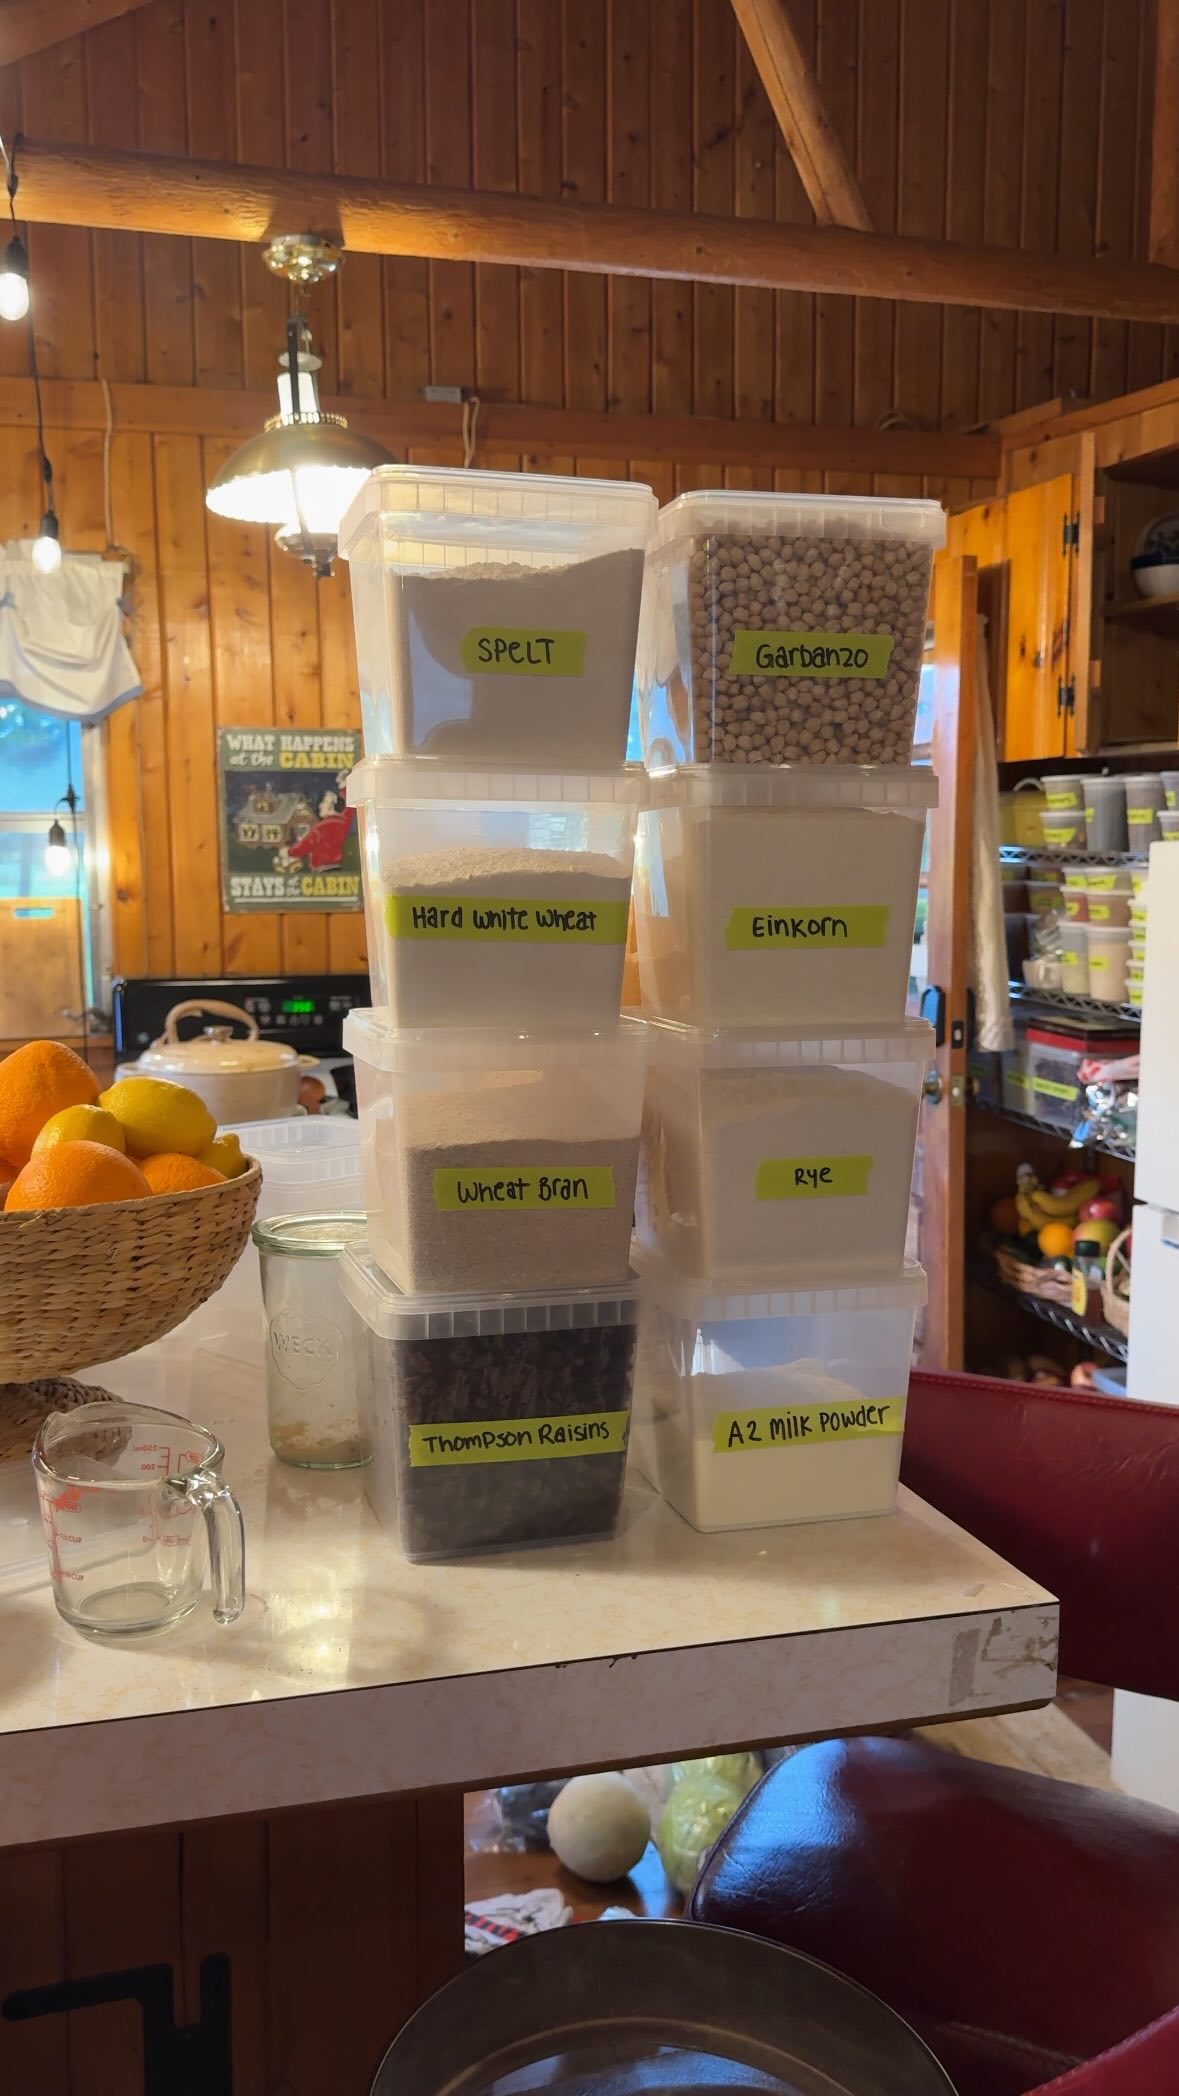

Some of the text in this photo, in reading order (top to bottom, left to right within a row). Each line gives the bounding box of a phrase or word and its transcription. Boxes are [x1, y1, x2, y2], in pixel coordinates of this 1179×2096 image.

[755, 643, 869, 669] Garbanzo
[226, 734, 356, 753] WHAT HAPPENS
[230, 751, 354, 769] at the CABIN
[231, 876, 285, 897] STAYS
[302, 876, 360, 897] CABIN
[412, 906, 463, 929] Hard
[752, 914, 848, 938] Einkorn
[538, 1176, 589, 1201] Bran
[794, 1166, 833, 1188] Rye
[273, 1331, 334, 1356] WECK
[422, 1420, 610, 1453] Thompson Raisins
[728, 1420, 762, 1448] A2
